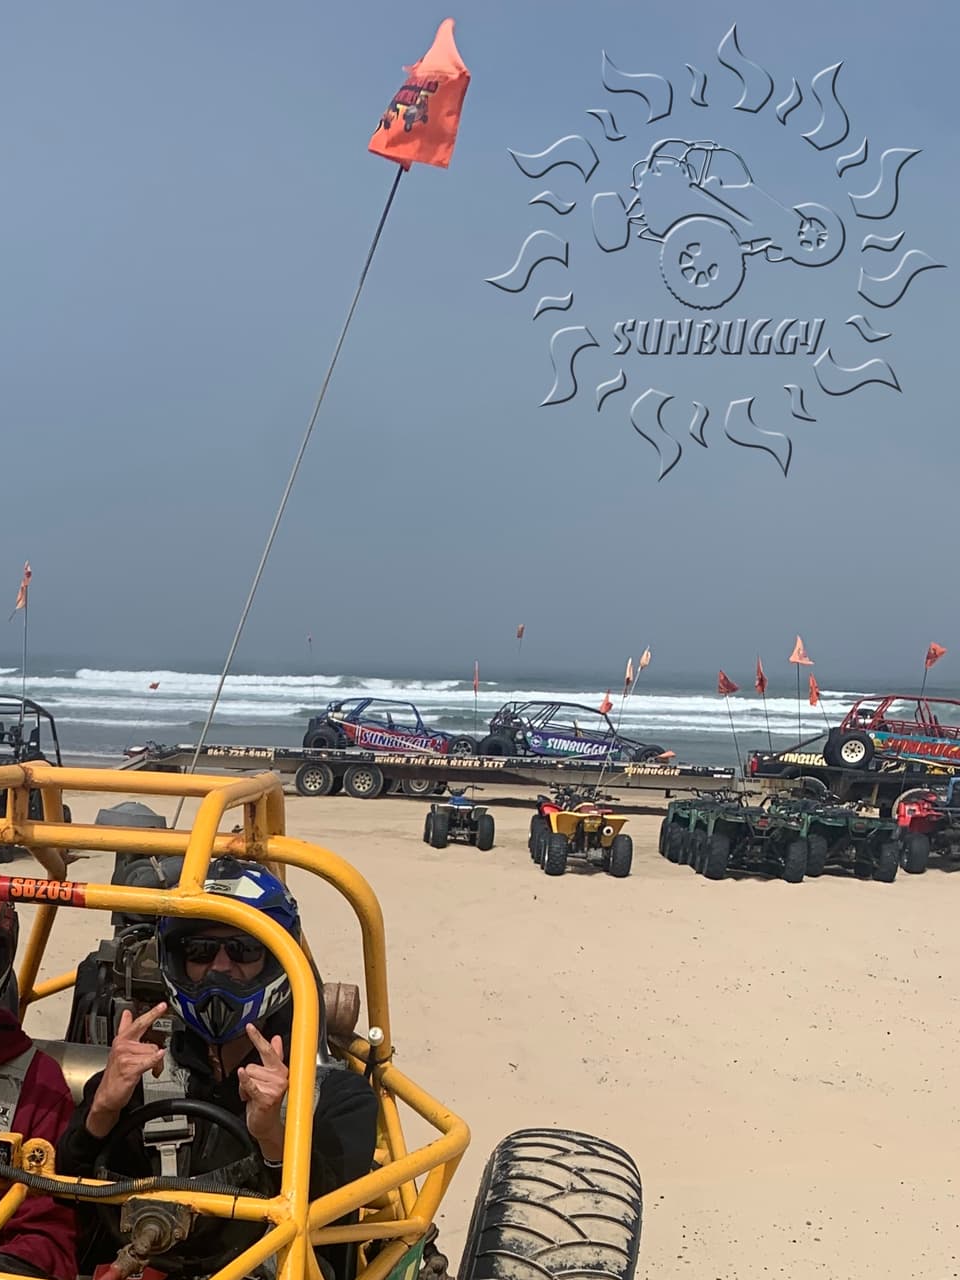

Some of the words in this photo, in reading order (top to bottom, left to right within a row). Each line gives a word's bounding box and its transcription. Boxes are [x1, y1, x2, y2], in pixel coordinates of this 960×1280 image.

[547, 737, 607, 755] SUNBUGGY
[374, 756, 406, 764] WHERE
[409, 757, 426, 765] THE
[428, 758, 449, 766] FUN
[450, 759, 481, 768] NEVER
[483, 760, 505, 768] SETS
[624, 767, 681, 777] SUNBUGGIE
[10, 878, 73, 899] SB203
